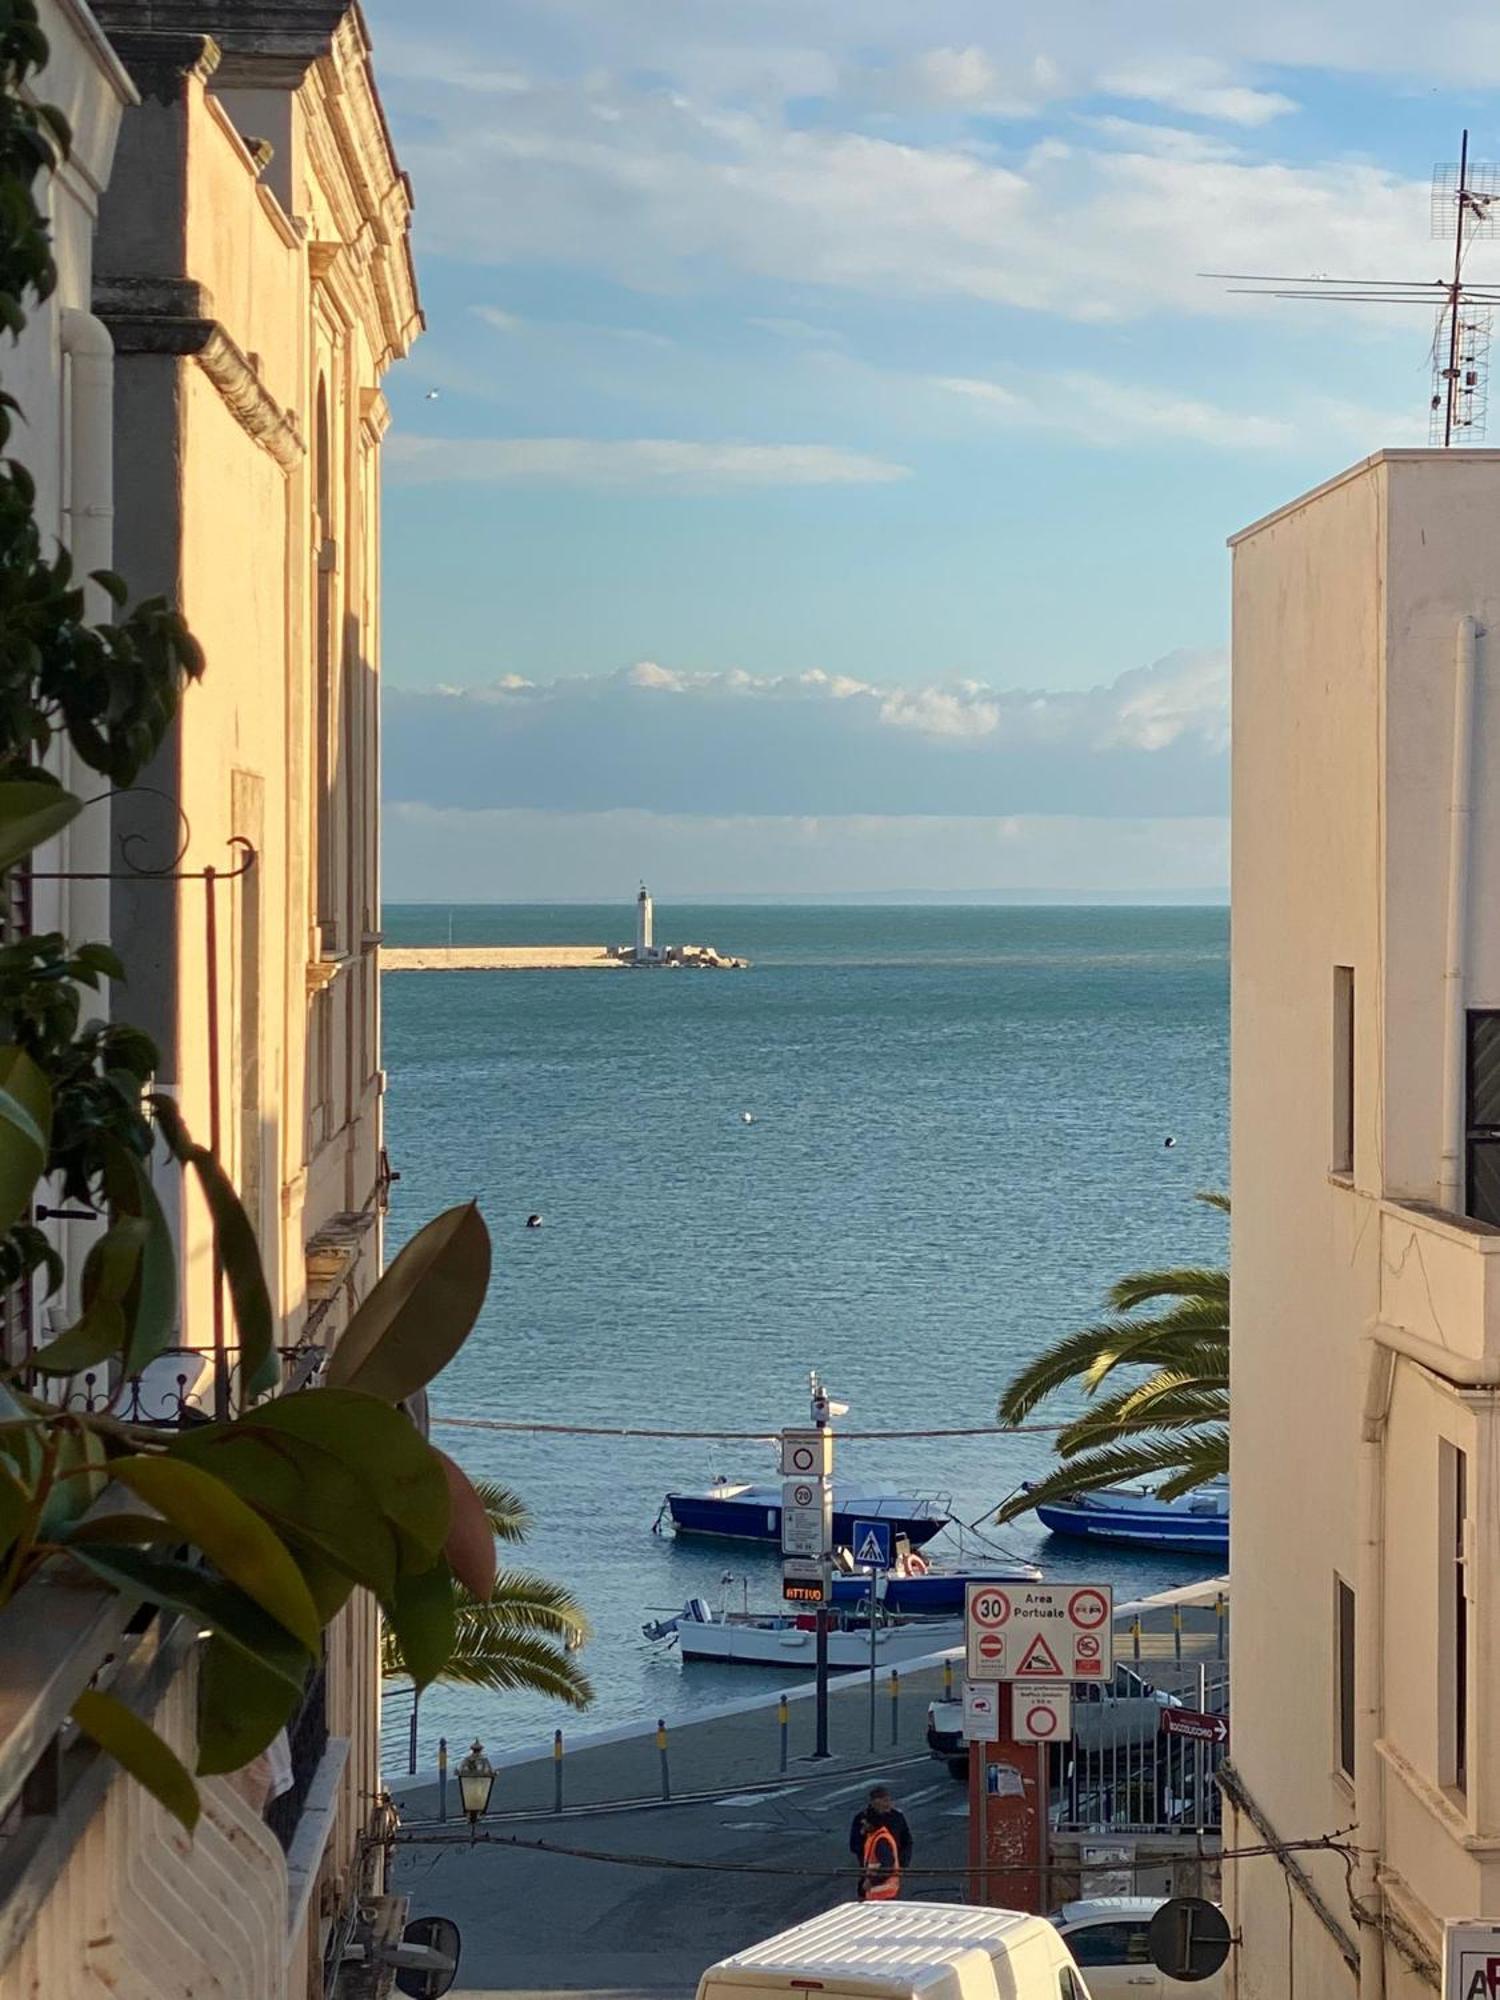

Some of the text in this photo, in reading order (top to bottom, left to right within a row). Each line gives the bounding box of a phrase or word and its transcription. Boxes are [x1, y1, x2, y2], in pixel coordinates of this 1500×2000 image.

[798, 1491, 809, 1501] 20
[786, 1588, 822, 1601] ATTIVO
[1025, 1594, 1053, 1604] Area
[981, 1599, 1002, 1618] 30
[1014, 1607, 1065, 1618] Portuale
